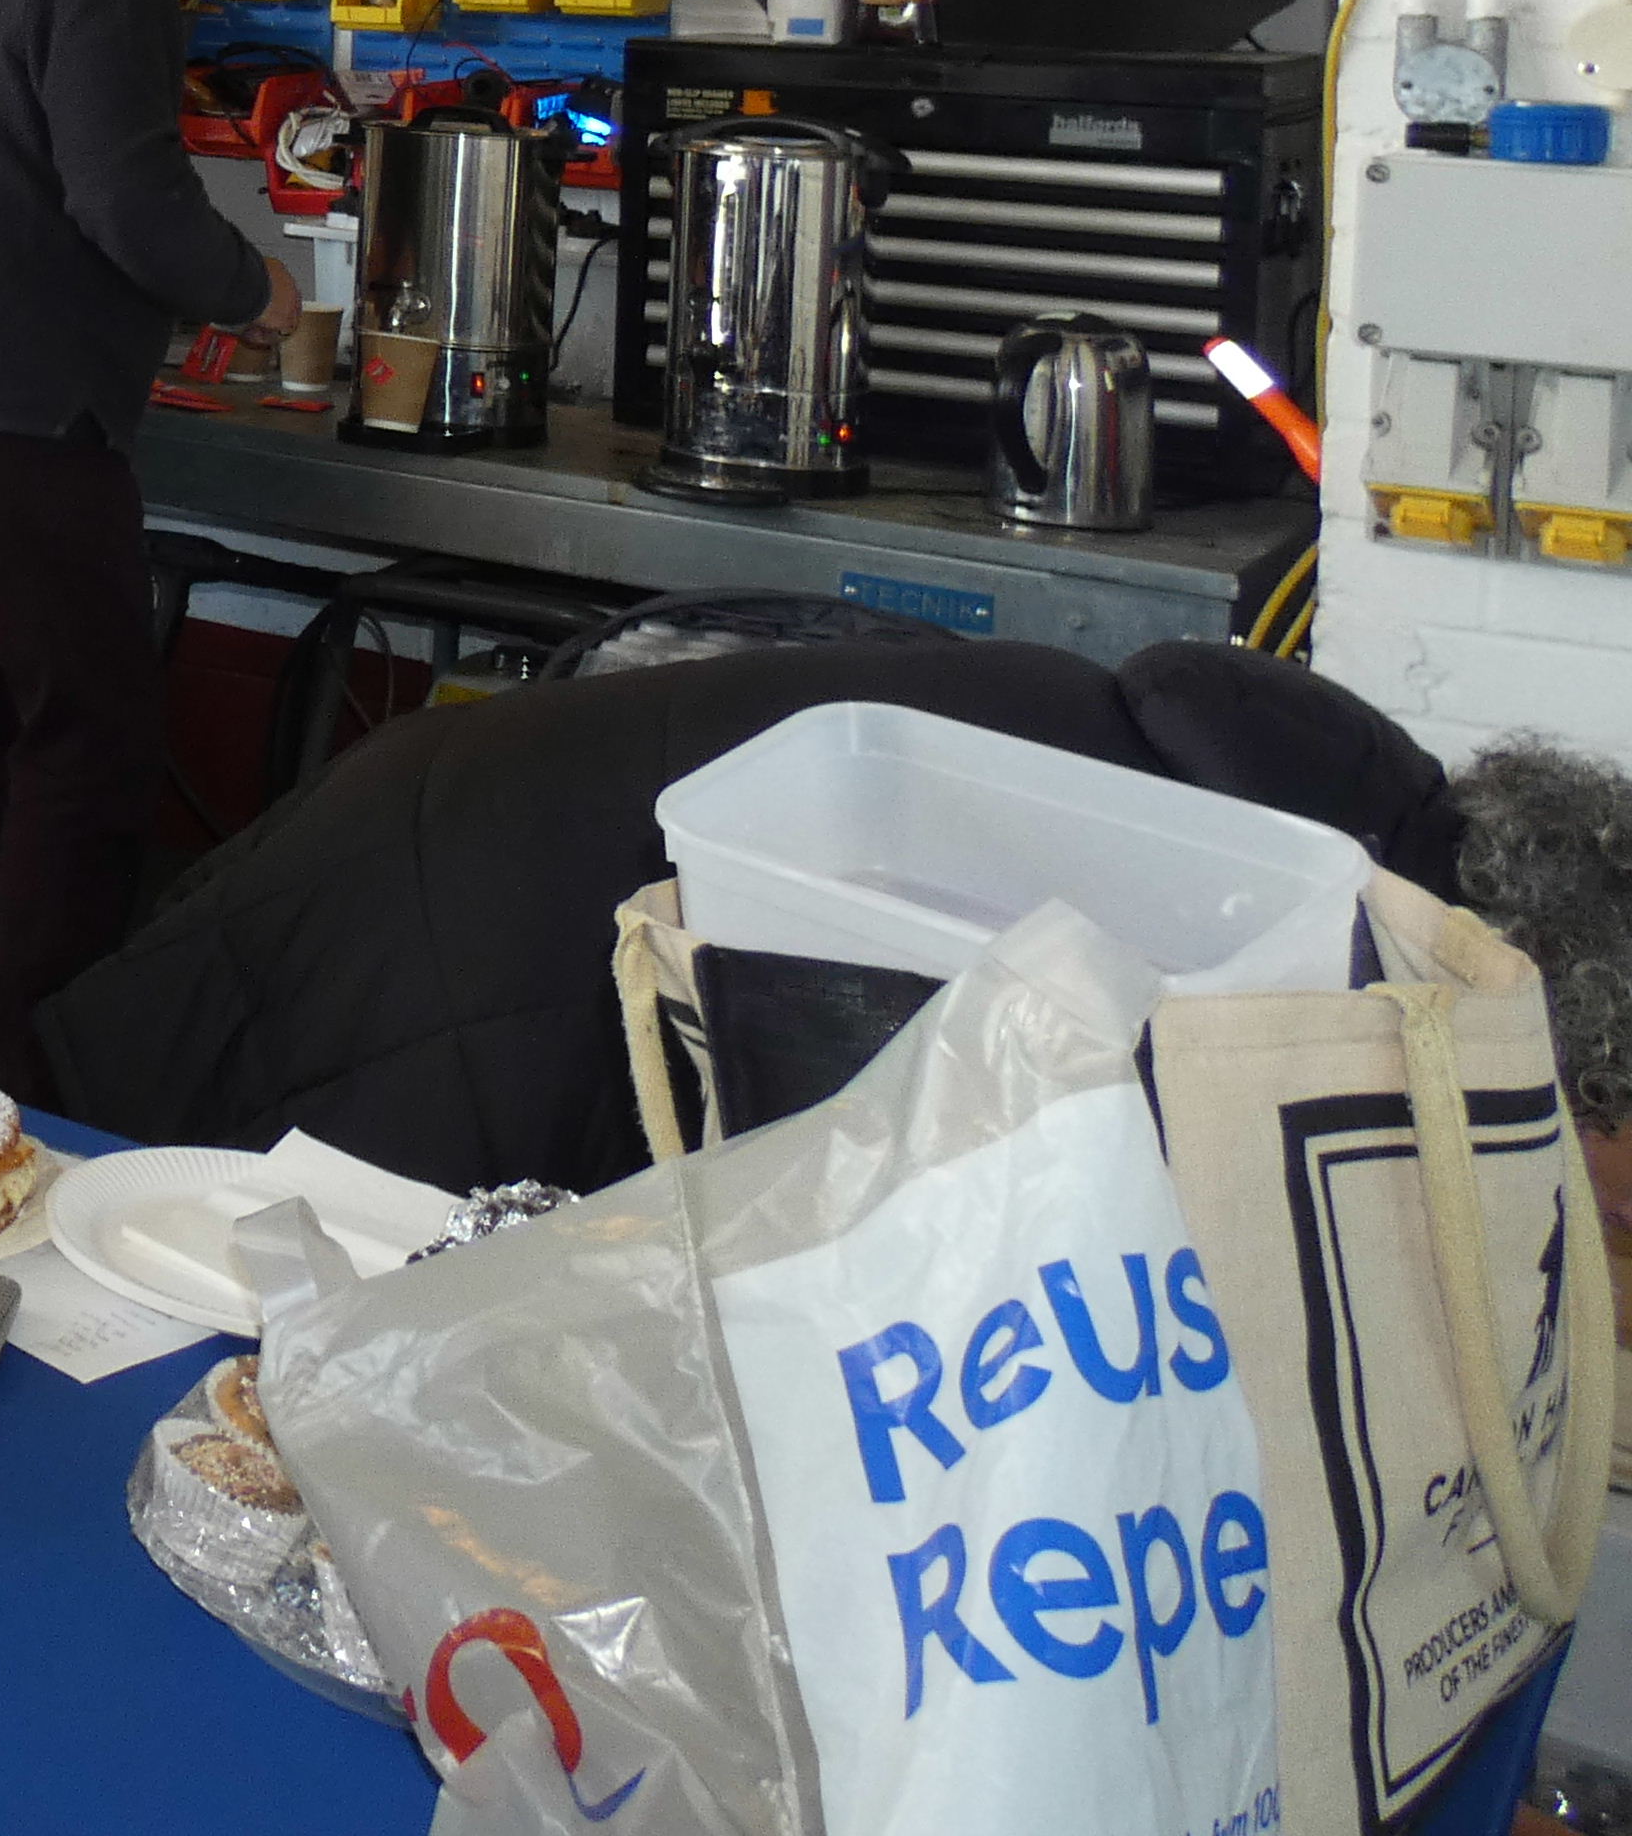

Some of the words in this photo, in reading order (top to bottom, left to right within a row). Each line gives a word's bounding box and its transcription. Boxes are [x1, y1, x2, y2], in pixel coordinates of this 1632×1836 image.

[1403, 1601, 1489, 1689] PRODUCERS
[1440, 1664, 1460, 1702] OF
[1461, 1642, 1491, 1680] THE
